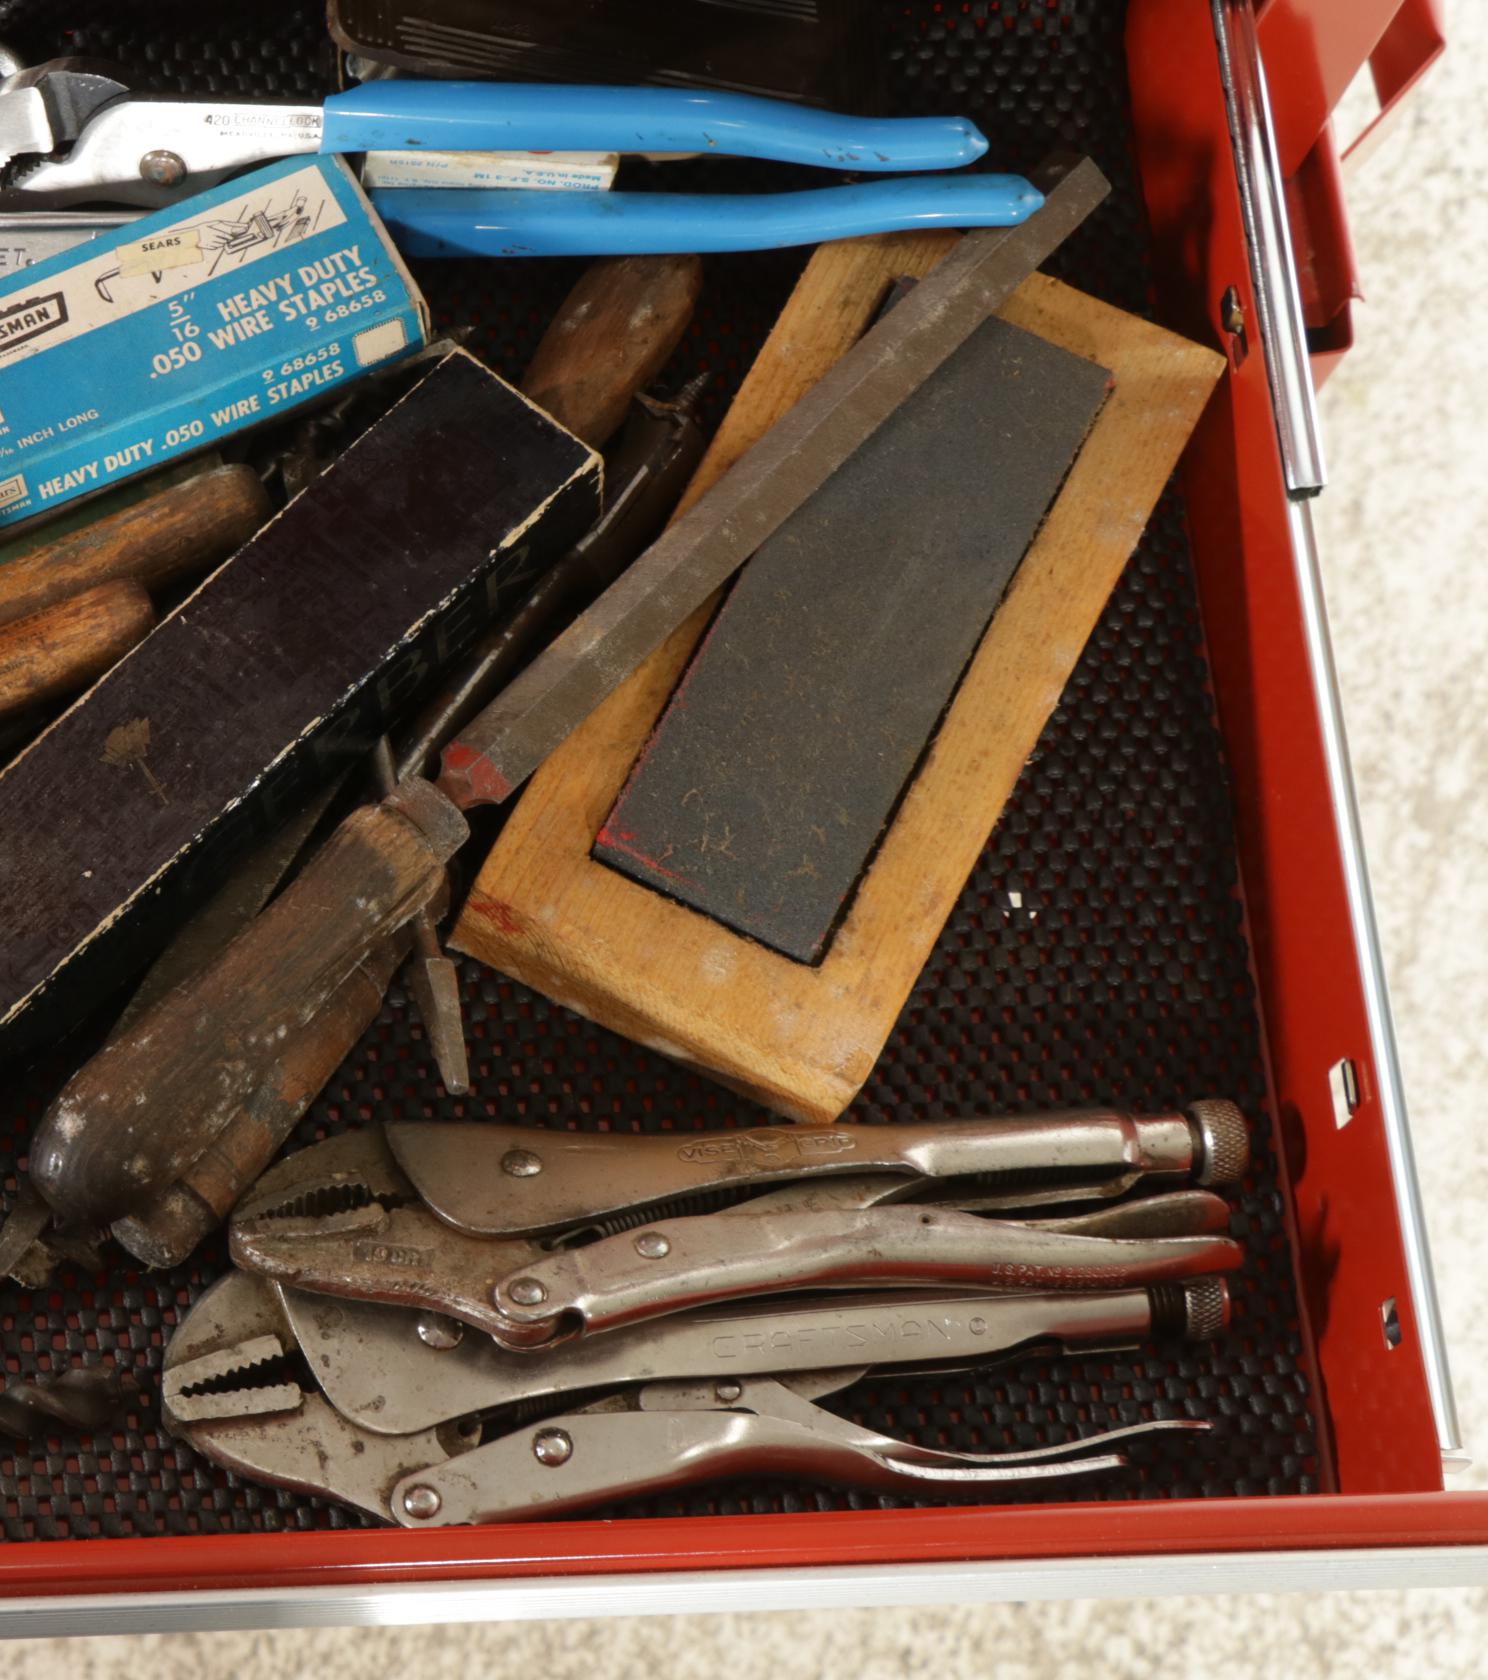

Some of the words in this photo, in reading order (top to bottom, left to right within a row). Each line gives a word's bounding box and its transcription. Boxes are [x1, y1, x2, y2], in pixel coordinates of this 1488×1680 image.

[141, 236, 182, 252] SEARS
[216, 273, 294, 322] HEAVY
[297, 245, 363, 287] DUTY
[149, 341, 203, 380] .050
[207, 309, 275, 350] WIRE
[278, 266, 378, 321] STAPLES
[323, 289, 388, 323] 68658
[279, 342, 341, 377] 68658
[16, 427, 55, 449] INCH
[58, 408, 100, 433] LONG
[38, 461, 99, 500] HEAVY
[104, 438, 154, 472] DUTY
[161, 418, 204, 450] .050
[211, 396, 262, 428] WIRE
[266, 360, 345, 405] STAPLES
[712, 1318, 959, 1358] CRAFTSMAN
